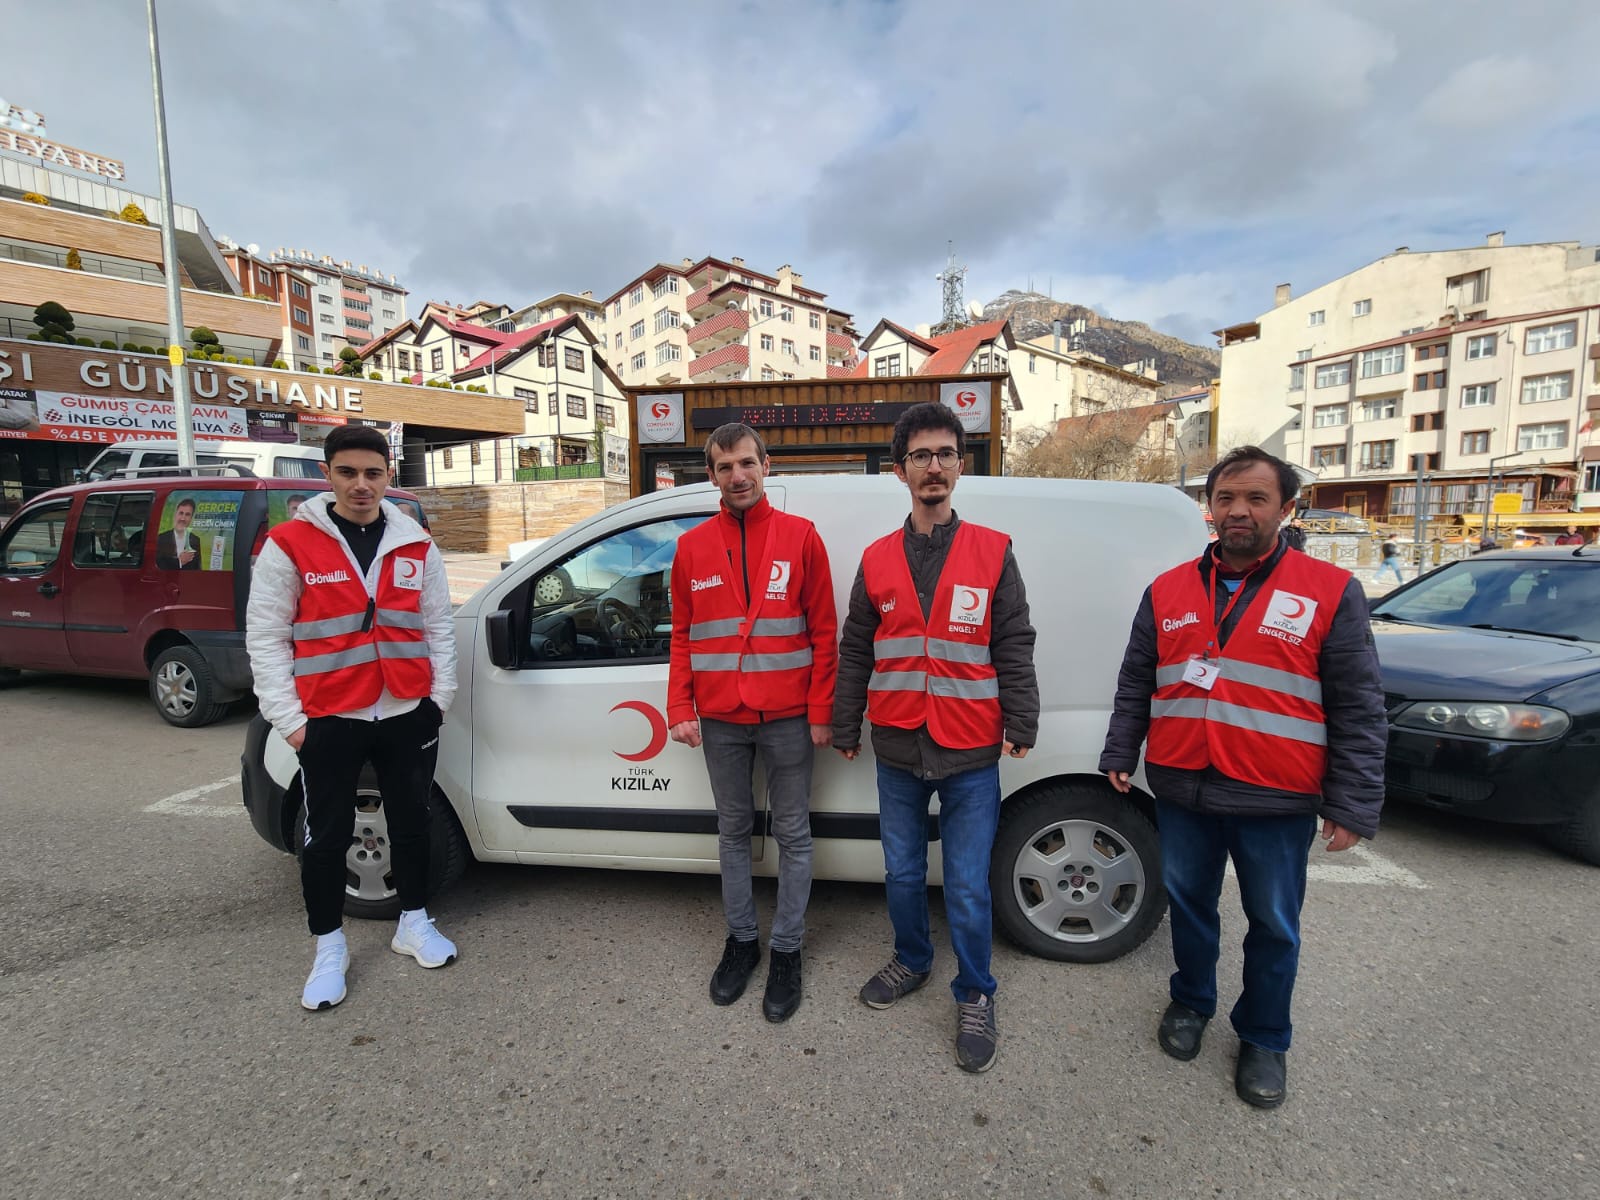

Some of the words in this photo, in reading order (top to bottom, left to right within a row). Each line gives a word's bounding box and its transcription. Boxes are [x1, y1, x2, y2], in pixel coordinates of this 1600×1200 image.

[0, 133, 122, 179] LYANS
[60, 395, 129, 412] GÜMÜŞ
[192, 407, 228, 420] AVM
[68, 410, 143, 428] İNEGÖL
[152, 419, 224, 433] MOİLYA
[50, 428, 108, 442] %45'E
[628, 766, 655, 776] TÜRK
[611, 777, 671, 791] KIZILAY
